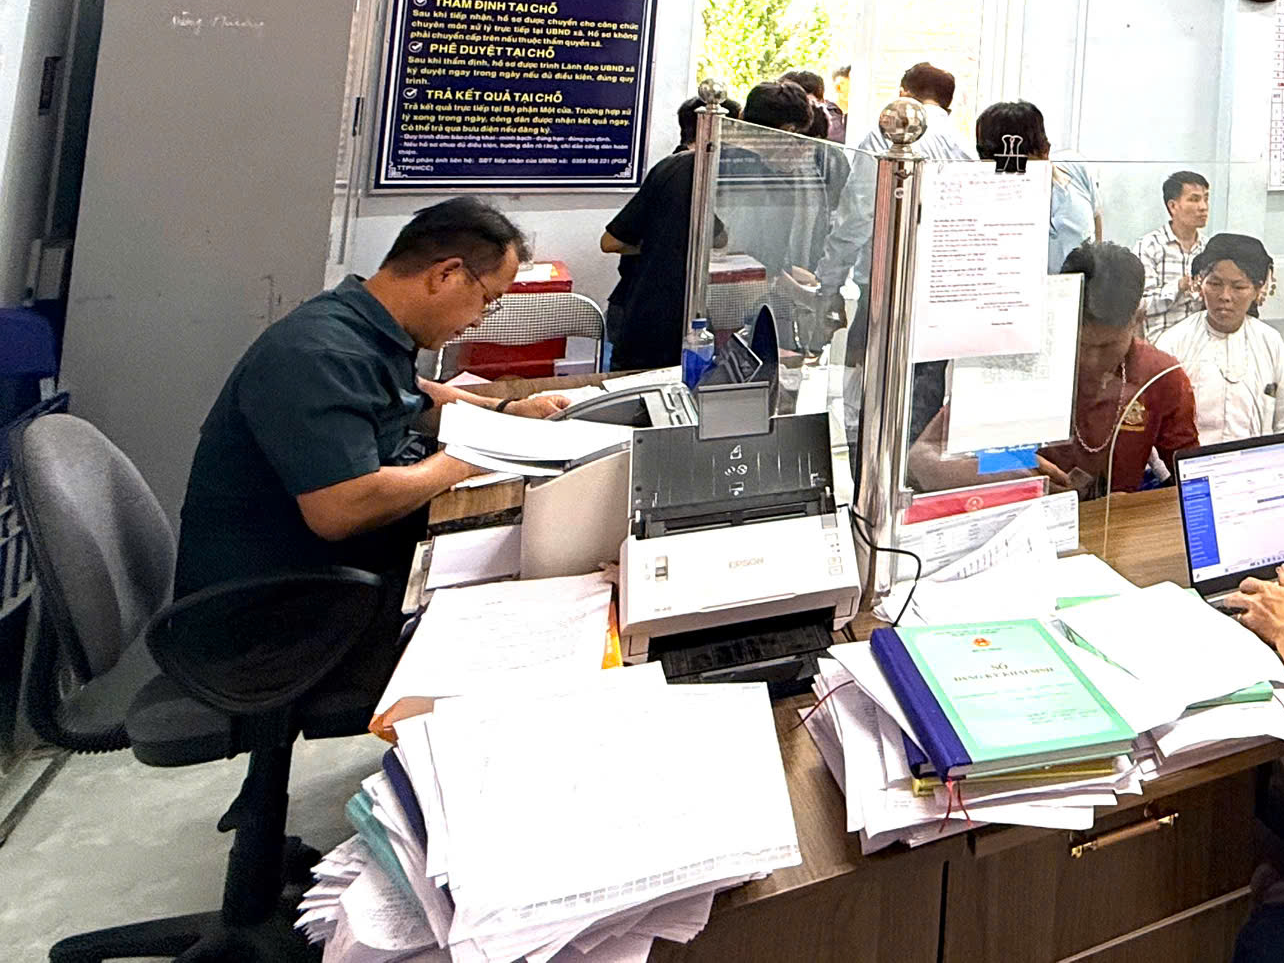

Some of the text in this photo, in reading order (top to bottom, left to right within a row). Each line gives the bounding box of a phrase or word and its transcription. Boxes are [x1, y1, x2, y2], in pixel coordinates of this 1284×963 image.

[474, 0, 505, 12] ĐỊNH
[507, 2, 527, 14] TẠI
[529, 0, 557, 14] CHỖ
[429, 40, 555, 58] PHÊ DUYỆT TẠI CHỖ
[425, 86, 563, 103] TRẢ KẾT QUẢ TẠI CHỖ
[728, 557, 764, 569] EPSON
